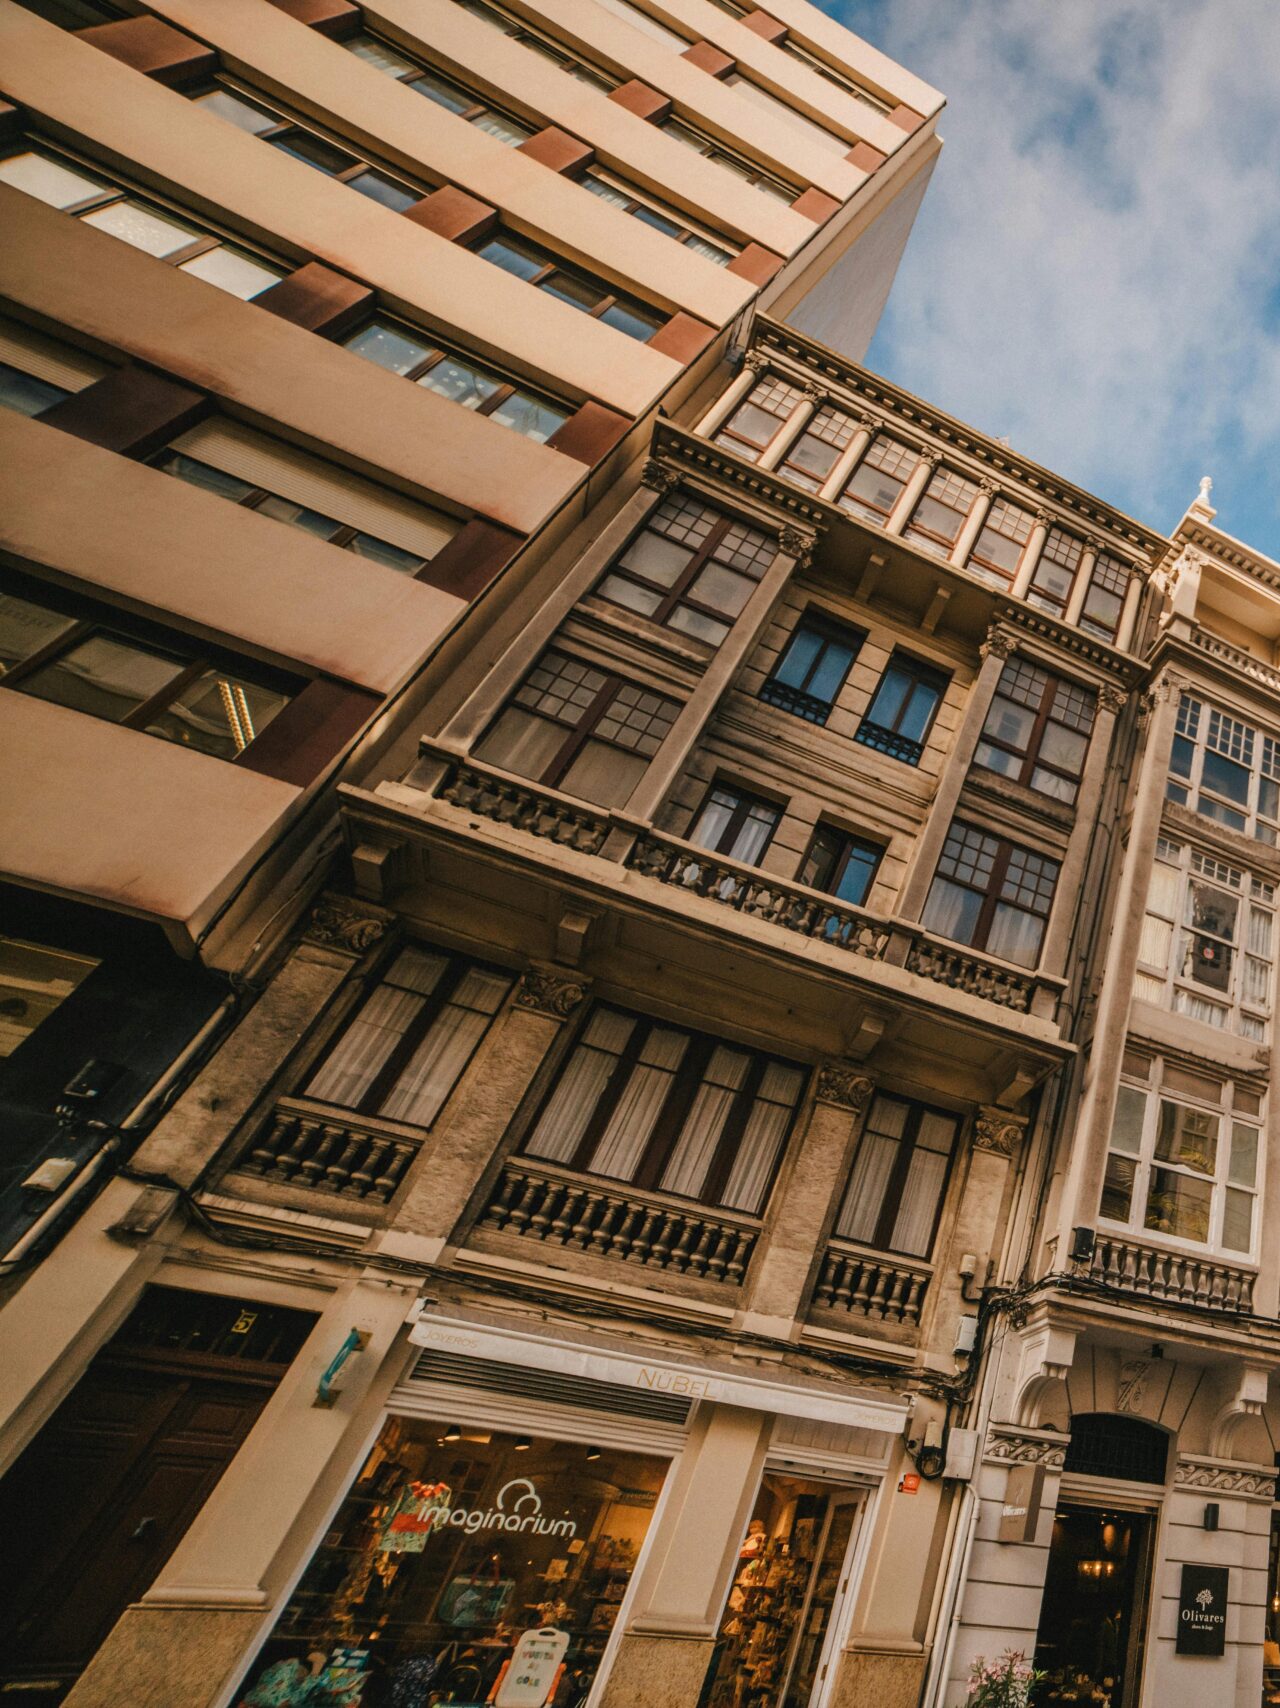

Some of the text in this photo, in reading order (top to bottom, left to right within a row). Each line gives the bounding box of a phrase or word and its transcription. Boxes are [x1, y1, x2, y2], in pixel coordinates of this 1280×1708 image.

[420, 1330, 478, 1349] JOYEROS
[416, 1504, 578, 1538] imaginarium
[1181, 1609, 1225, 1624] Olivares
